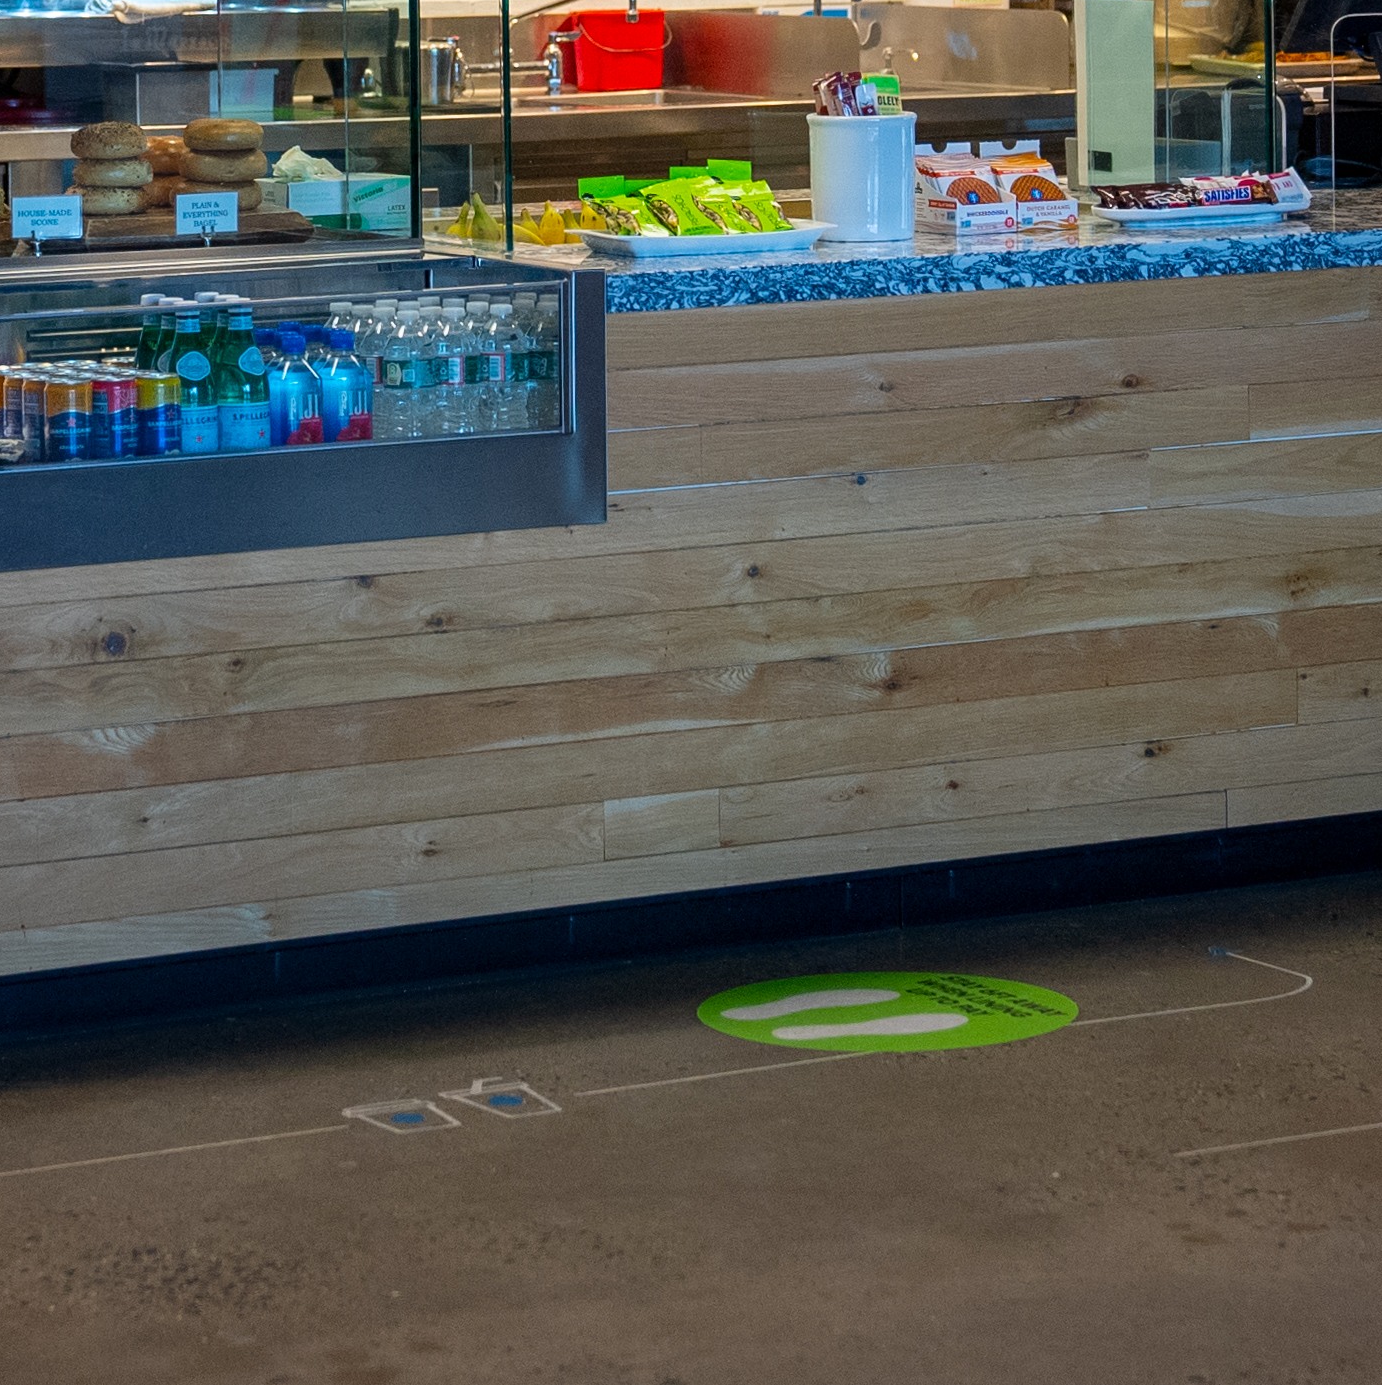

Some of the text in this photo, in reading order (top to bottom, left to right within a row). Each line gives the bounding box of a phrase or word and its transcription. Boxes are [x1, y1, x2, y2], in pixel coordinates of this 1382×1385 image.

[1204, 186, 1251, 203] SATISFIES
[191, 201, 212, 210] PLAIN
[387, 204, 406, 212] LATEX
[17, 209, 73, 218] HOUSE-MADE
[182, 209, 229, 220] EVERYTHING
[31, 218, 59, 227] SCONE
